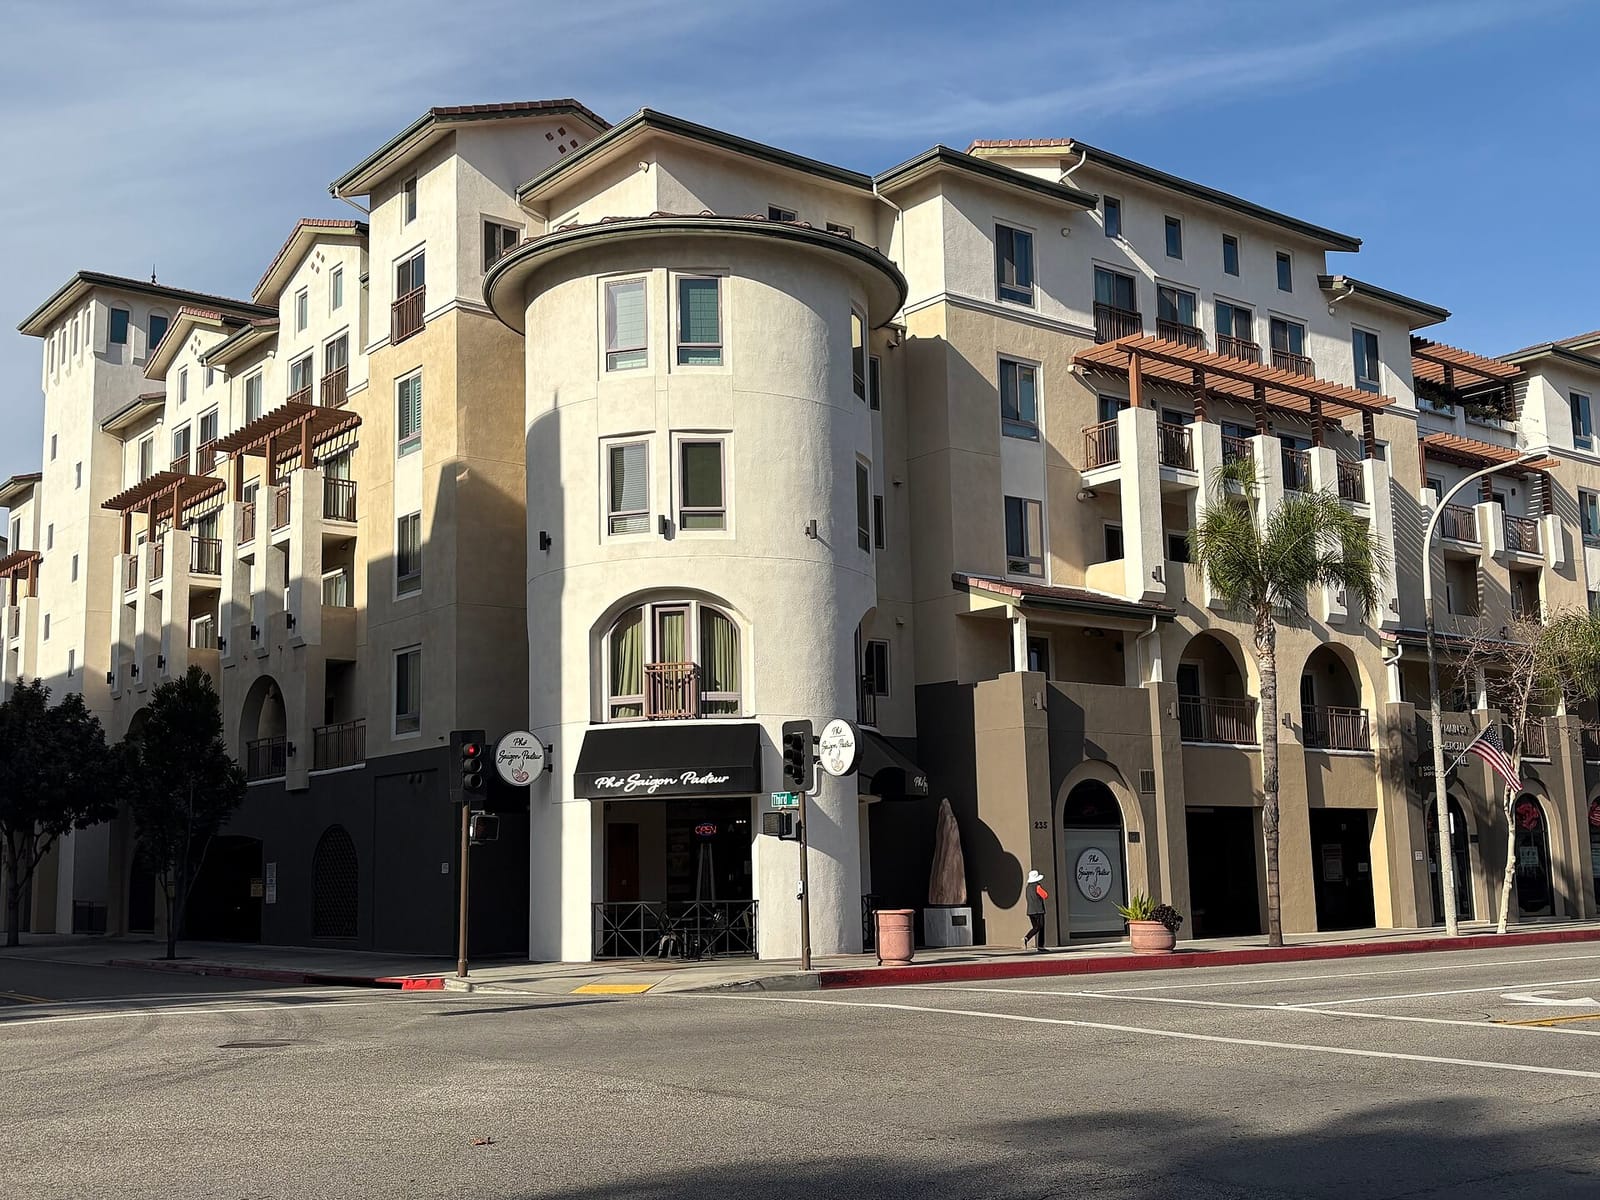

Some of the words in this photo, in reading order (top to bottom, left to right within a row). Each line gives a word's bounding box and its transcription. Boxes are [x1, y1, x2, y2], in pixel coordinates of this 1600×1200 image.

[498, 749, 521, 765] Saigon
[521, 749, 543, 760] Pasteur
[624, 773, 678, 794] Saigon
[680, 771, 730, 785] Pasteur
[773, 793, 788, 805] Third
[695, 825, 717, 834] OPEN
[1034, 821, 1048, 829] 235
